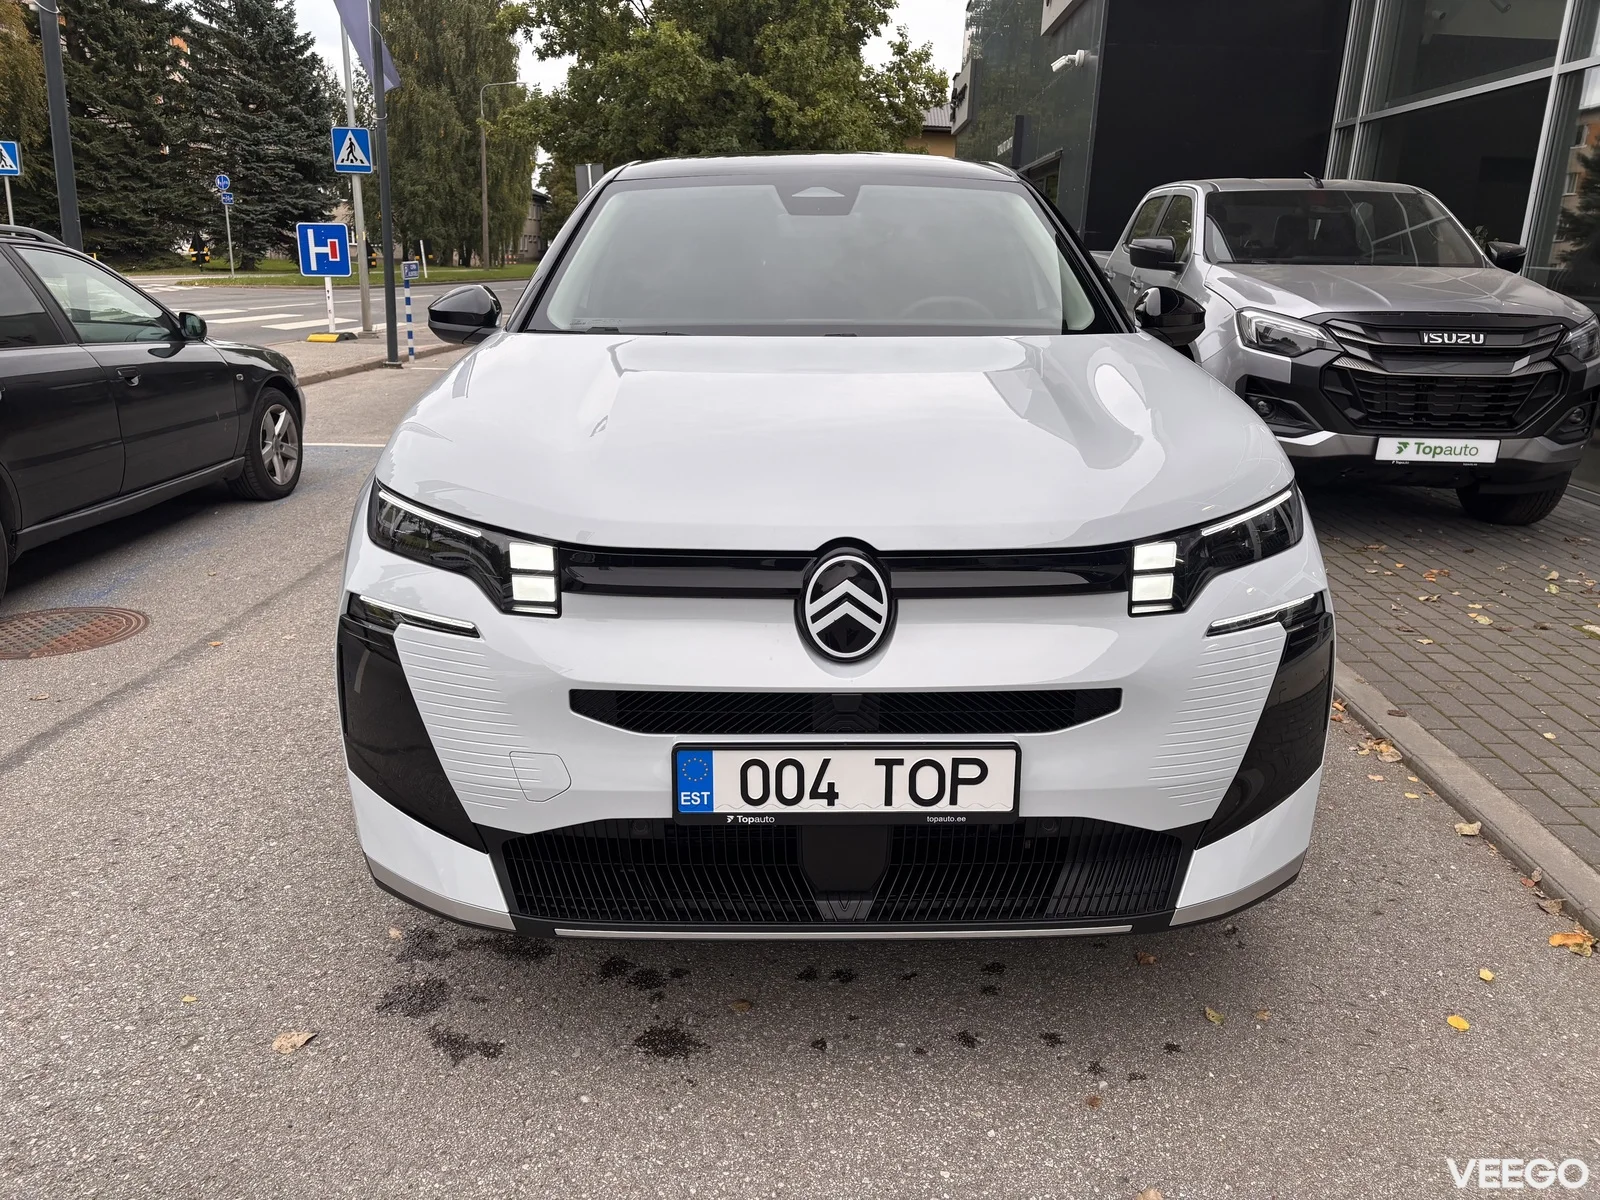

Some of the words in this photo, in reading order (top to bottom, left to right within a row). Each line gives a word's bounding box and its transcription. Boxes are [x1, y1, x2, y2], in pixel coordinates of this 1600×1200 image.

[1423, 332, 1485, 345] ISUZU
[1414, 441, 1479, 459] Topauto
[739, 757, 840, 807] 004
[874, 757, 989, 807] TOP
[680, 791, 711, 806] EST
[736, 815, 775, 825] Topauto
[926, 815, 967, 824] topauto.ee
